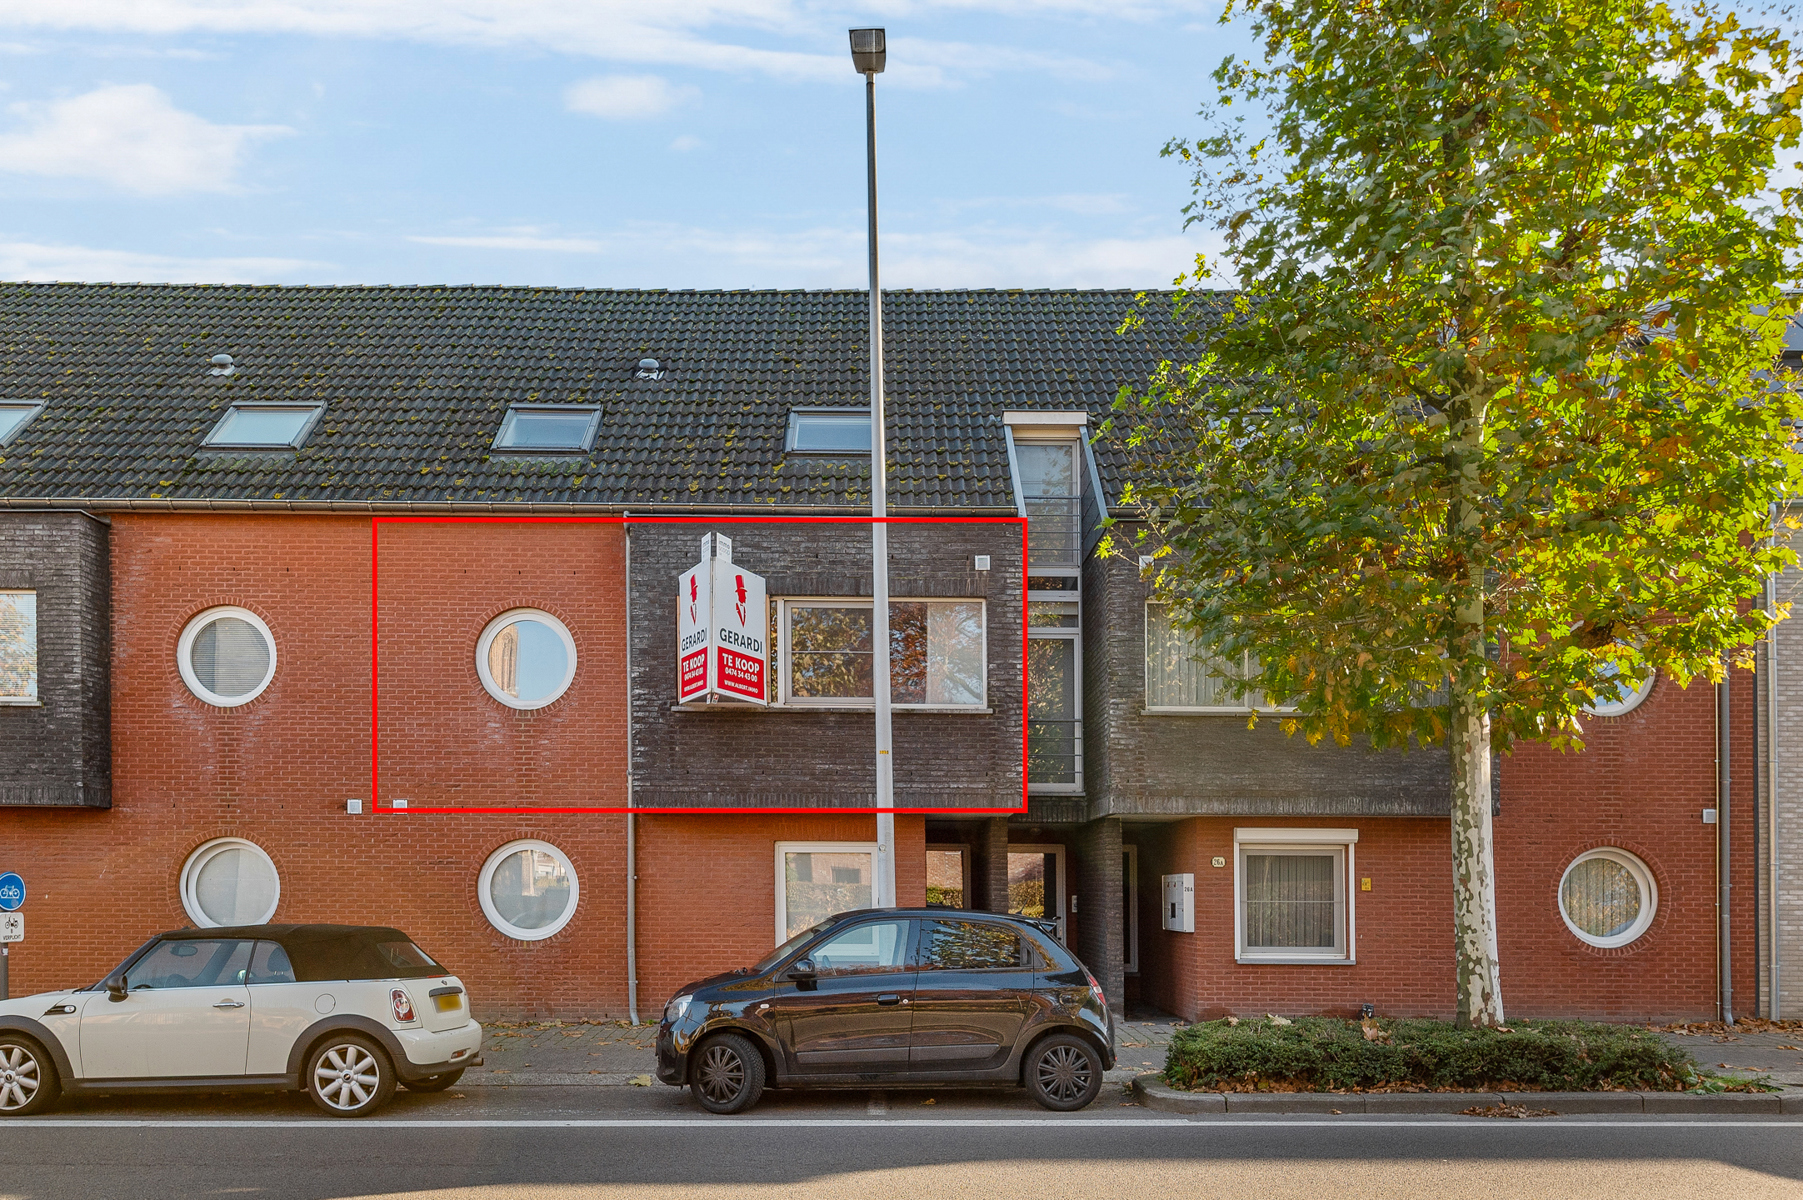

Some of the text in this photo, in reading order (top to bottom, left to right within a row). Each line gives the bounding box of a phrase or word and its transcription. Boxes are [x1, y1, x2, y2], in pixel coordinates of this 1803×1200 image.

[681, 628, 707, 651] GERARDI
[720, 628, 762, 654] GERARDI
[683, 654, 705, 673] TE KOOP
[722, 653, 760, 674] TE KOOP
[724, 667, 758, 683] 0474 34 43 00
